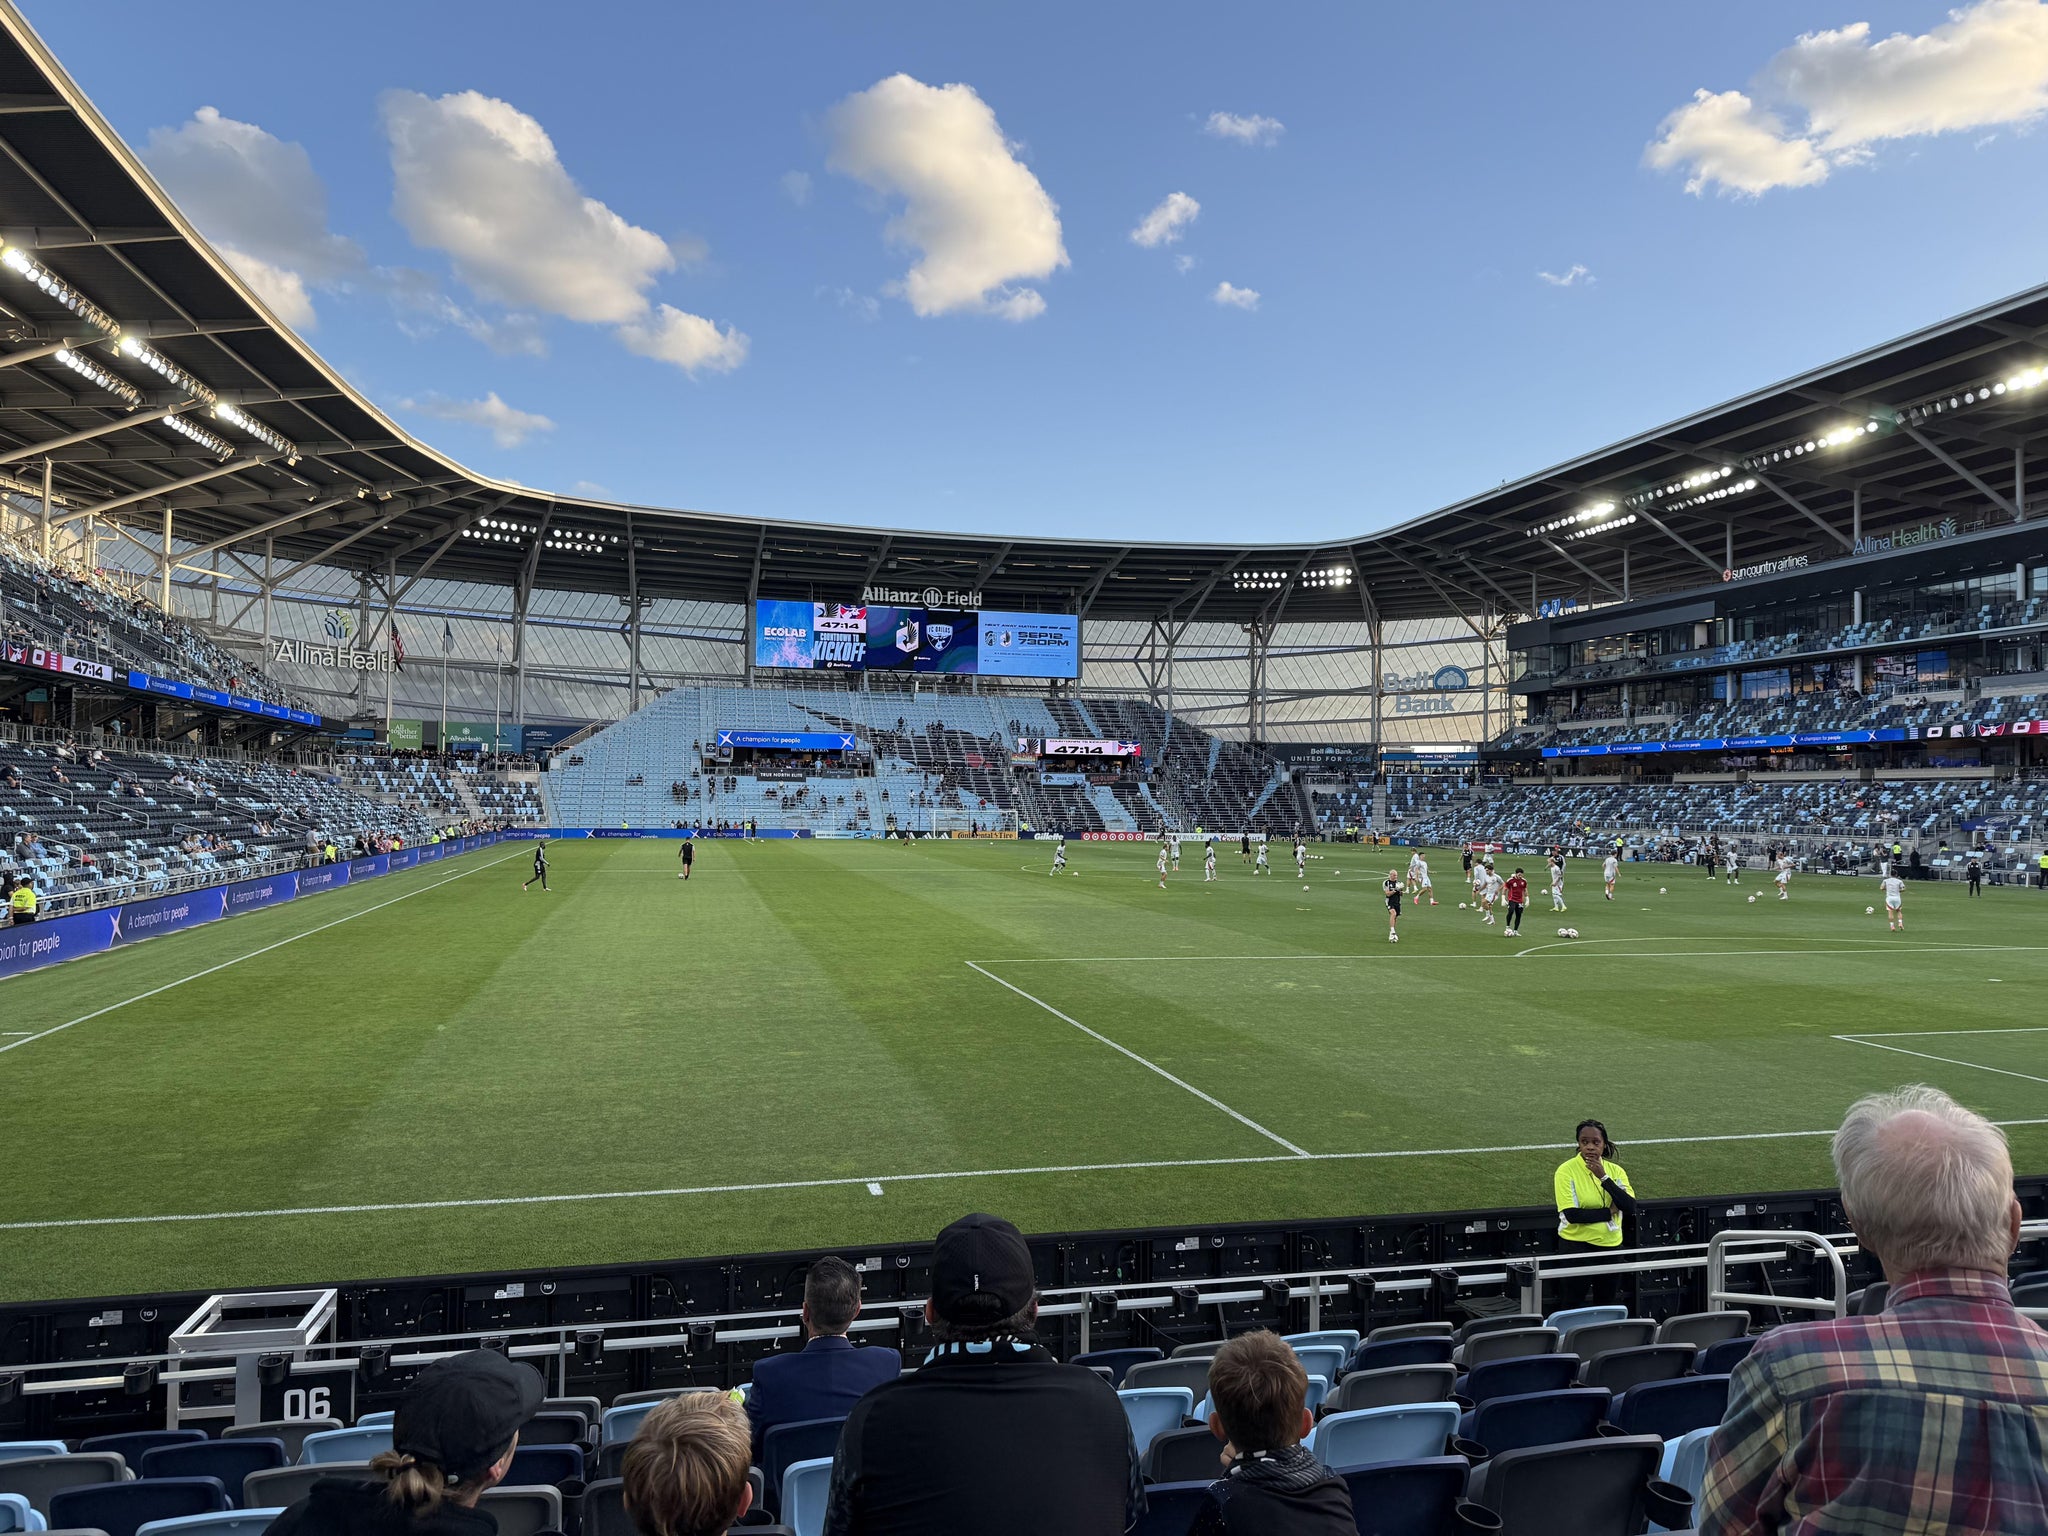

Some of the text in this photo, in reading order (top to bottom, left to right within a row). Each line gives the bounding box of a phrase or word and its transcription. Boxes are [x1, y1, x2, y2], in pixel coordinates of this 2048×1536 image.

[1852, 522, 1938, 555] Allina Health
[1732, 555, 1808, 579] sun country airlines
[861, 586, 982, 606] Allianz Field
[764, 627, 807, 637] ECOLAB
[820, 632, 852, 641] COUNTDOWN
[935, 626, 951, 634] DALLAS
[275, 640, 335, 666] Allina
[813, 641, 867, 662] KICKOFF
[73, 661, 103, 678] 47:14
[1384, 671, 1429, 691] Bell
[1396, 690, 1455, 712] Bank
[1054, 746, 1103, 754] 47:14
[1034, 832, 1065, 840] Gillette
[128, 903, 189, 930] A champion for people
[19, 939, 31, 957] for
[32, 932, 60, 958] people
[284, 1387, 331, 1420] 06
